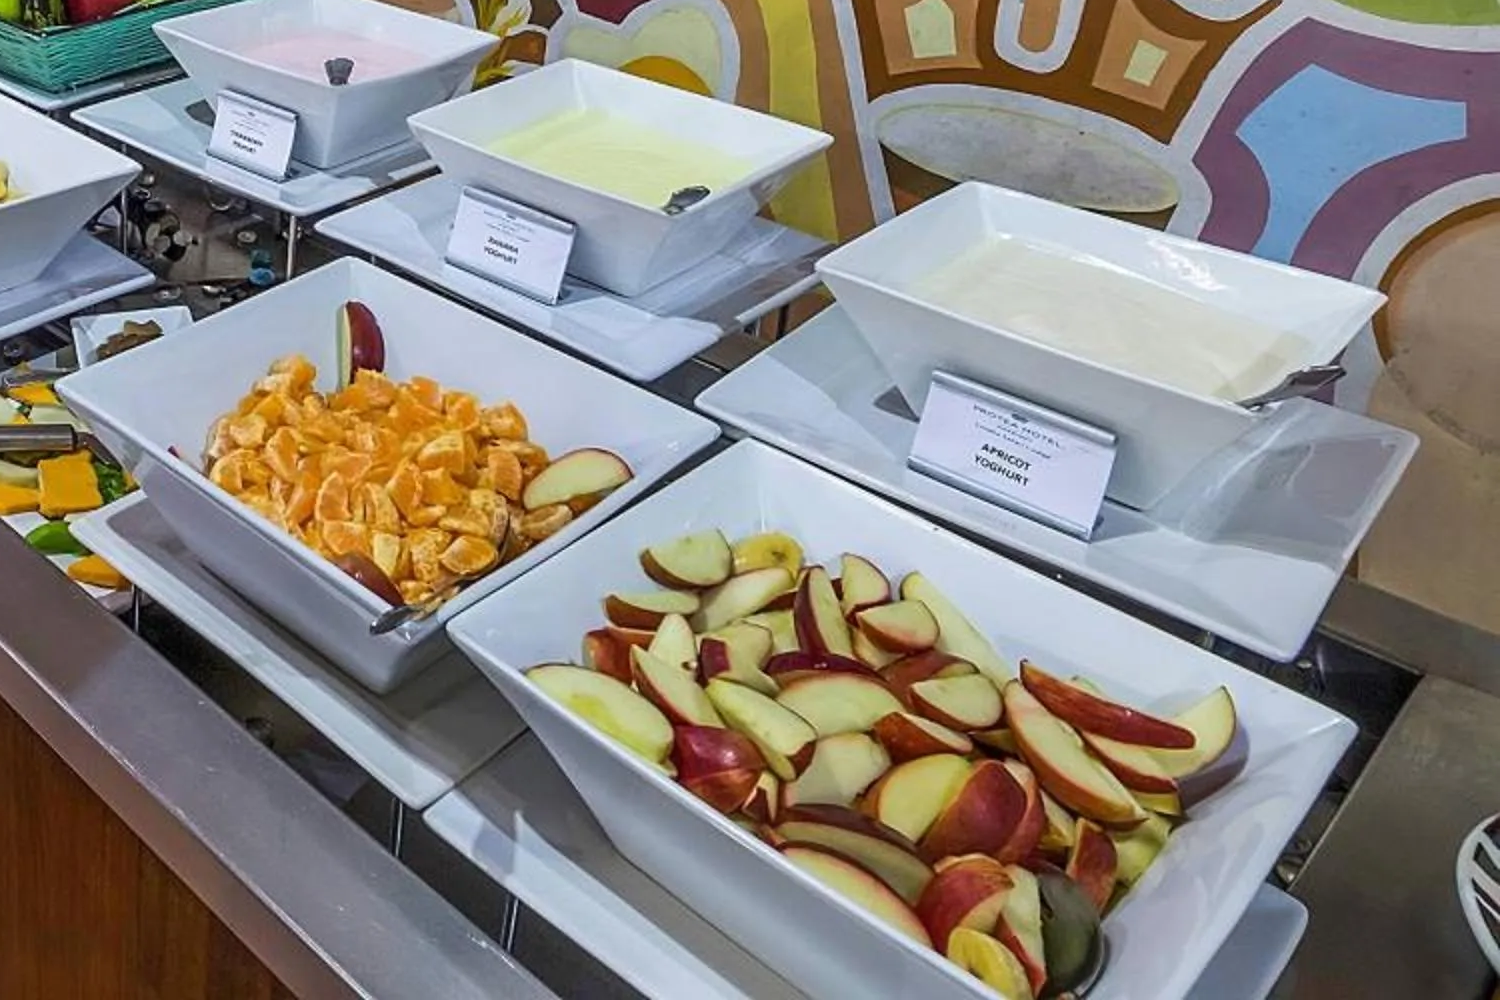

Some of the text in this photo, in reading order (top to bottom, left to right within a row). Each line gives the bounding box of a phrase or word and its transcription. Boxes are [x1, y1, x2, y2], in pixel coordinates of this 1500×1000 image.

[1021, 426, 1061, 449] HOTEL
[975, 454, 1029, 486] YOGHURT
[981, 443, 1032, 471] APRICOT
